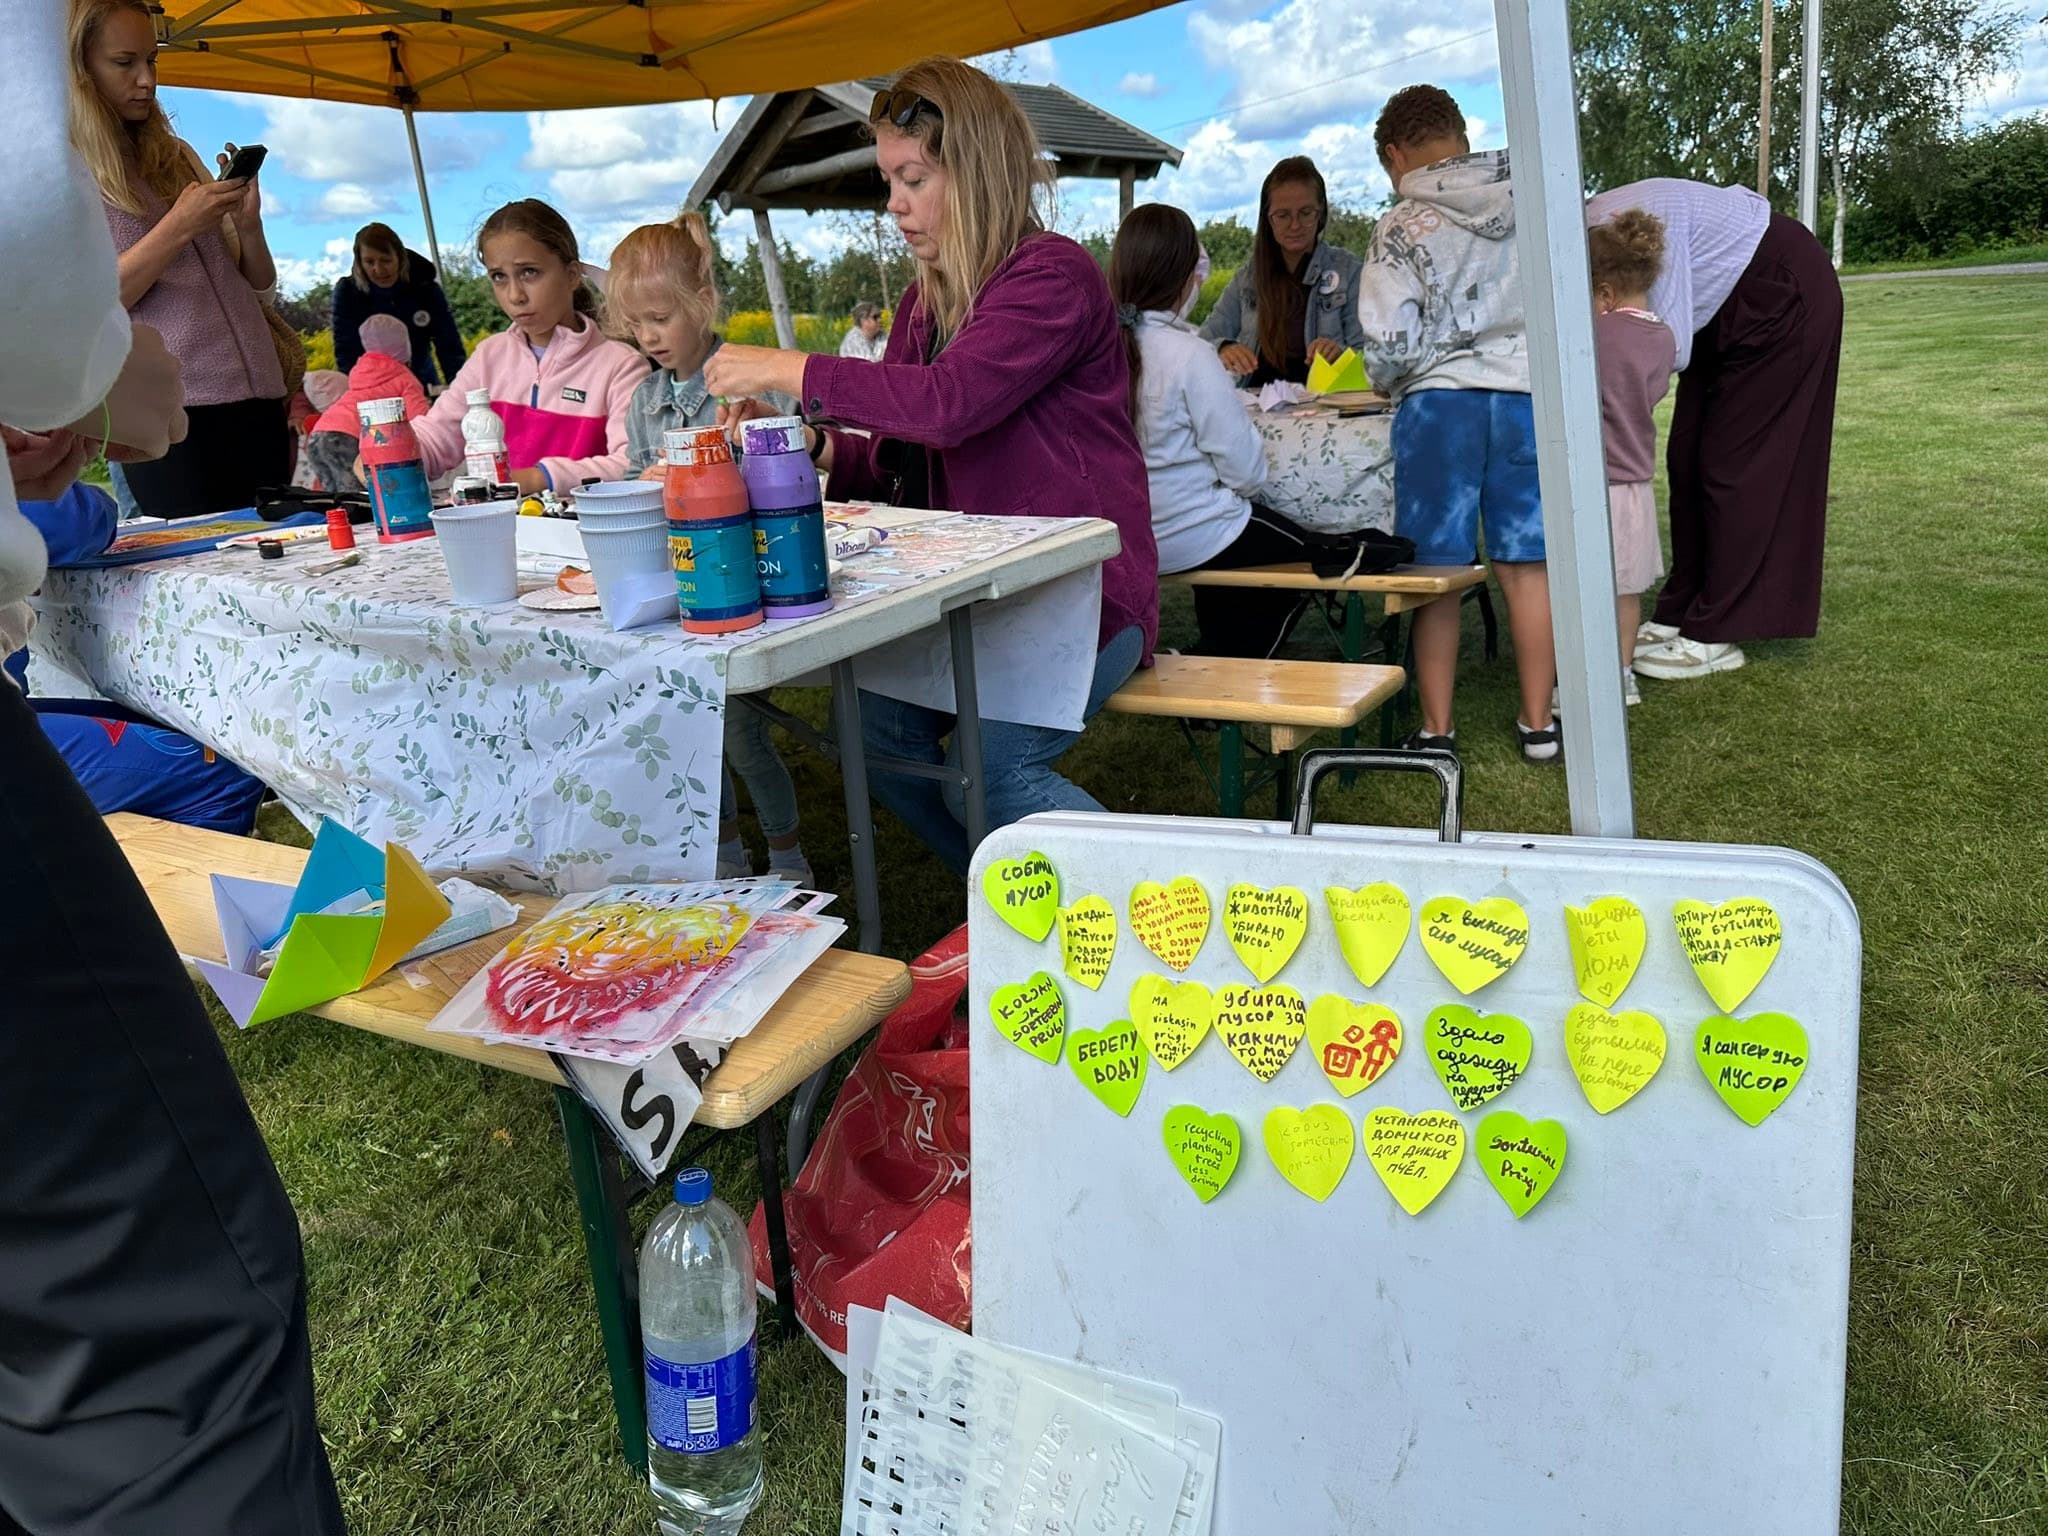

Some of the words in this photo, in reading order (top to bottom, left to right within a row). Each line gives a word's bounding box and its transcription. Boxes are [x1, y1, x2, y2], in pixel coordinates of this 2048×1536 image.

[835, 541, 866, 556] bloom
[1218, 1010, 1275, 1027] мусор
[1078, 1029, 1139, 1063] БЕРЕГУ
[1702, 1034, 1712, 1056] Я
[1093, 1055, 1140, 1085] ВОДУ
[1718, 1066, 1789, 1093] МУСОР
[1374, 1114, 1460, 1130] УСТАНОВКА
[1184, 1122, 1233, 1156] recycling
[1371, 1128, 1458, 1147] ДОМИКОВ
[1181, 1138, 1224, 1163] planting
[1372, 1144, 1401, 1158] ДЛЯ
[1402, 1144, 1450, 1161] ДИКИХ
[1188, 1164, 1209, 1176] less
[1195, 1152, 1221, 1171] trees
